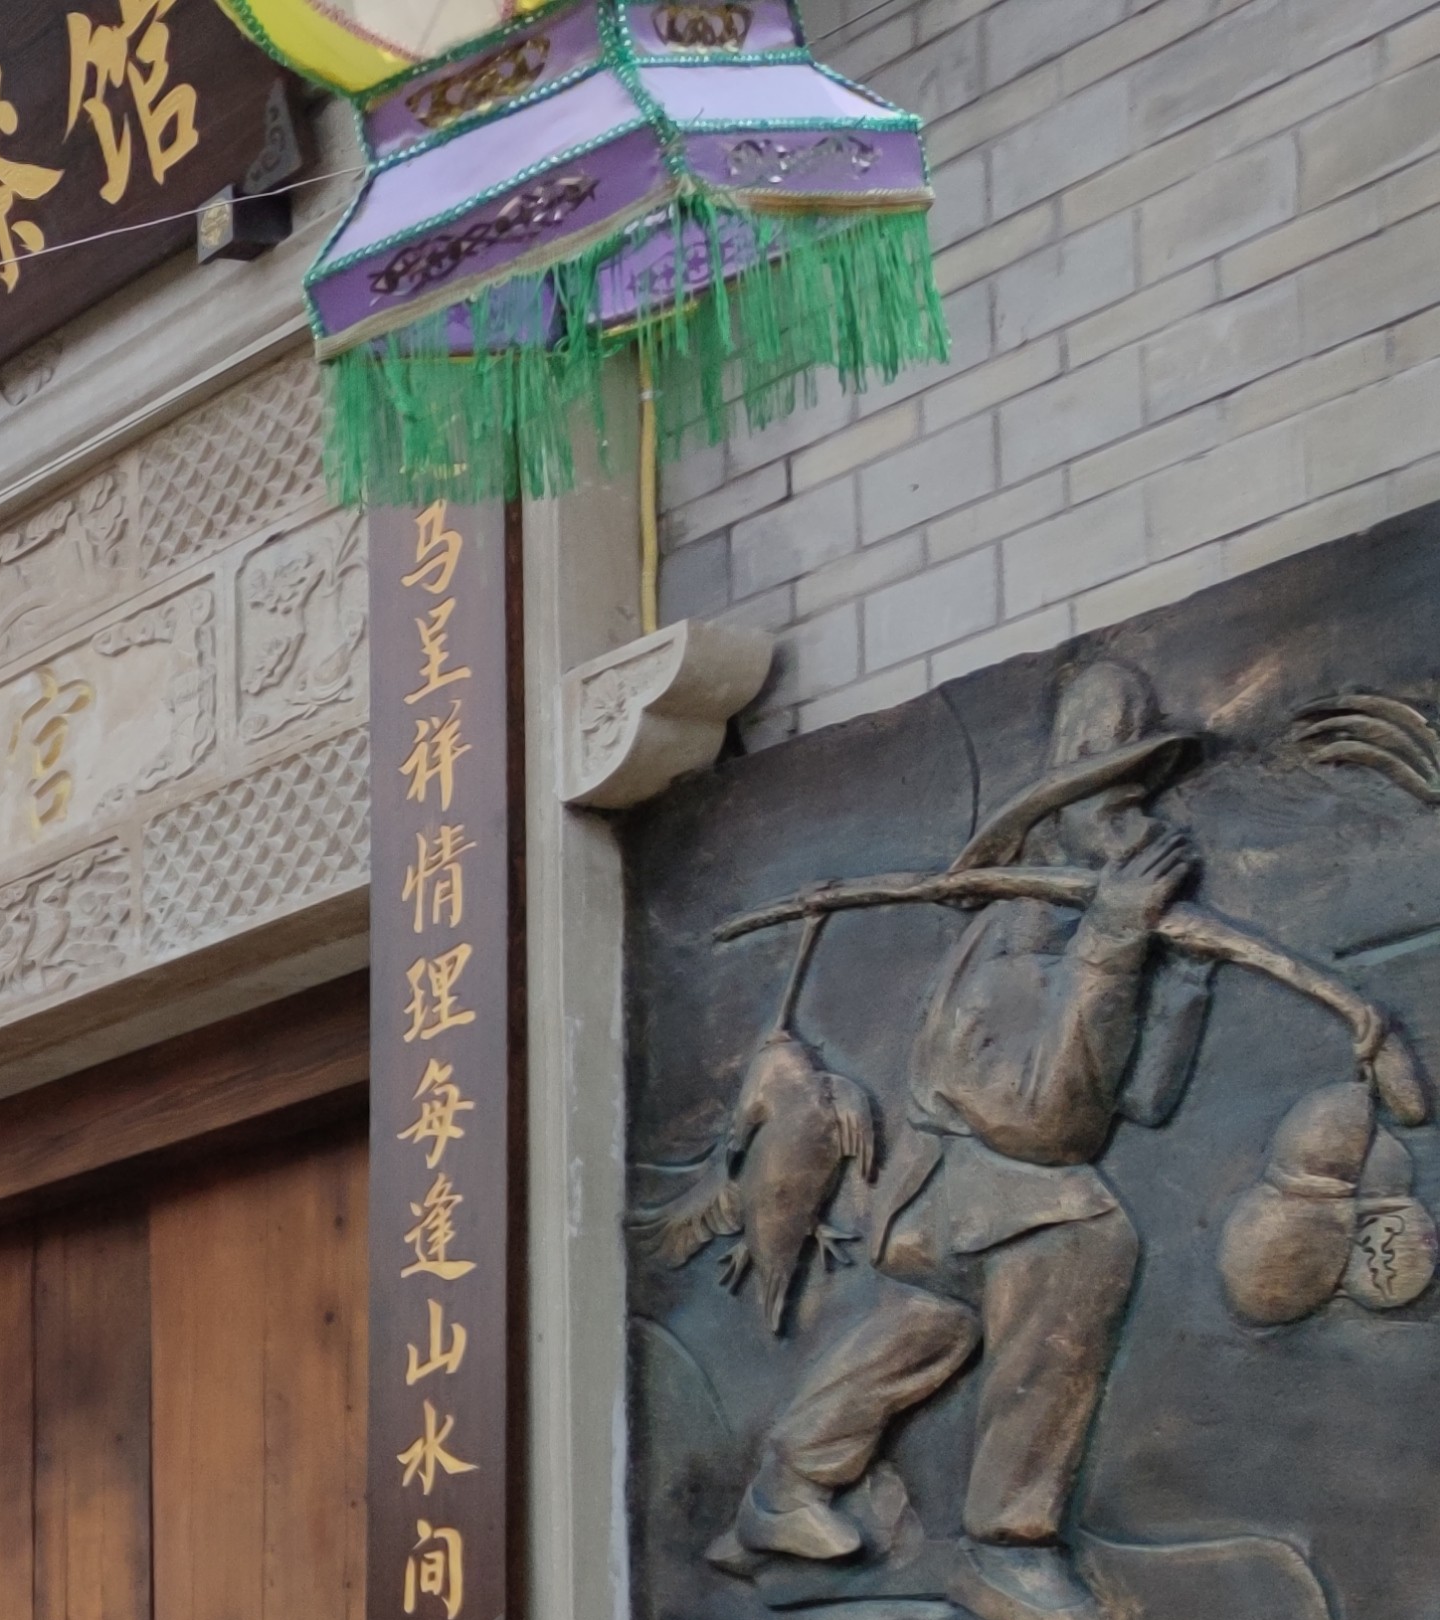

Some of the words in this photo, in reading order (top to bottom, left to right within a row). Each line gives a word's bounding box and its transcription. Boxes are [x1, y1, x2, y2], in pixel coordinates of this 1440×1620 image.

[396, 480, 480, 1620] 马呈祥情理每逢山水间
